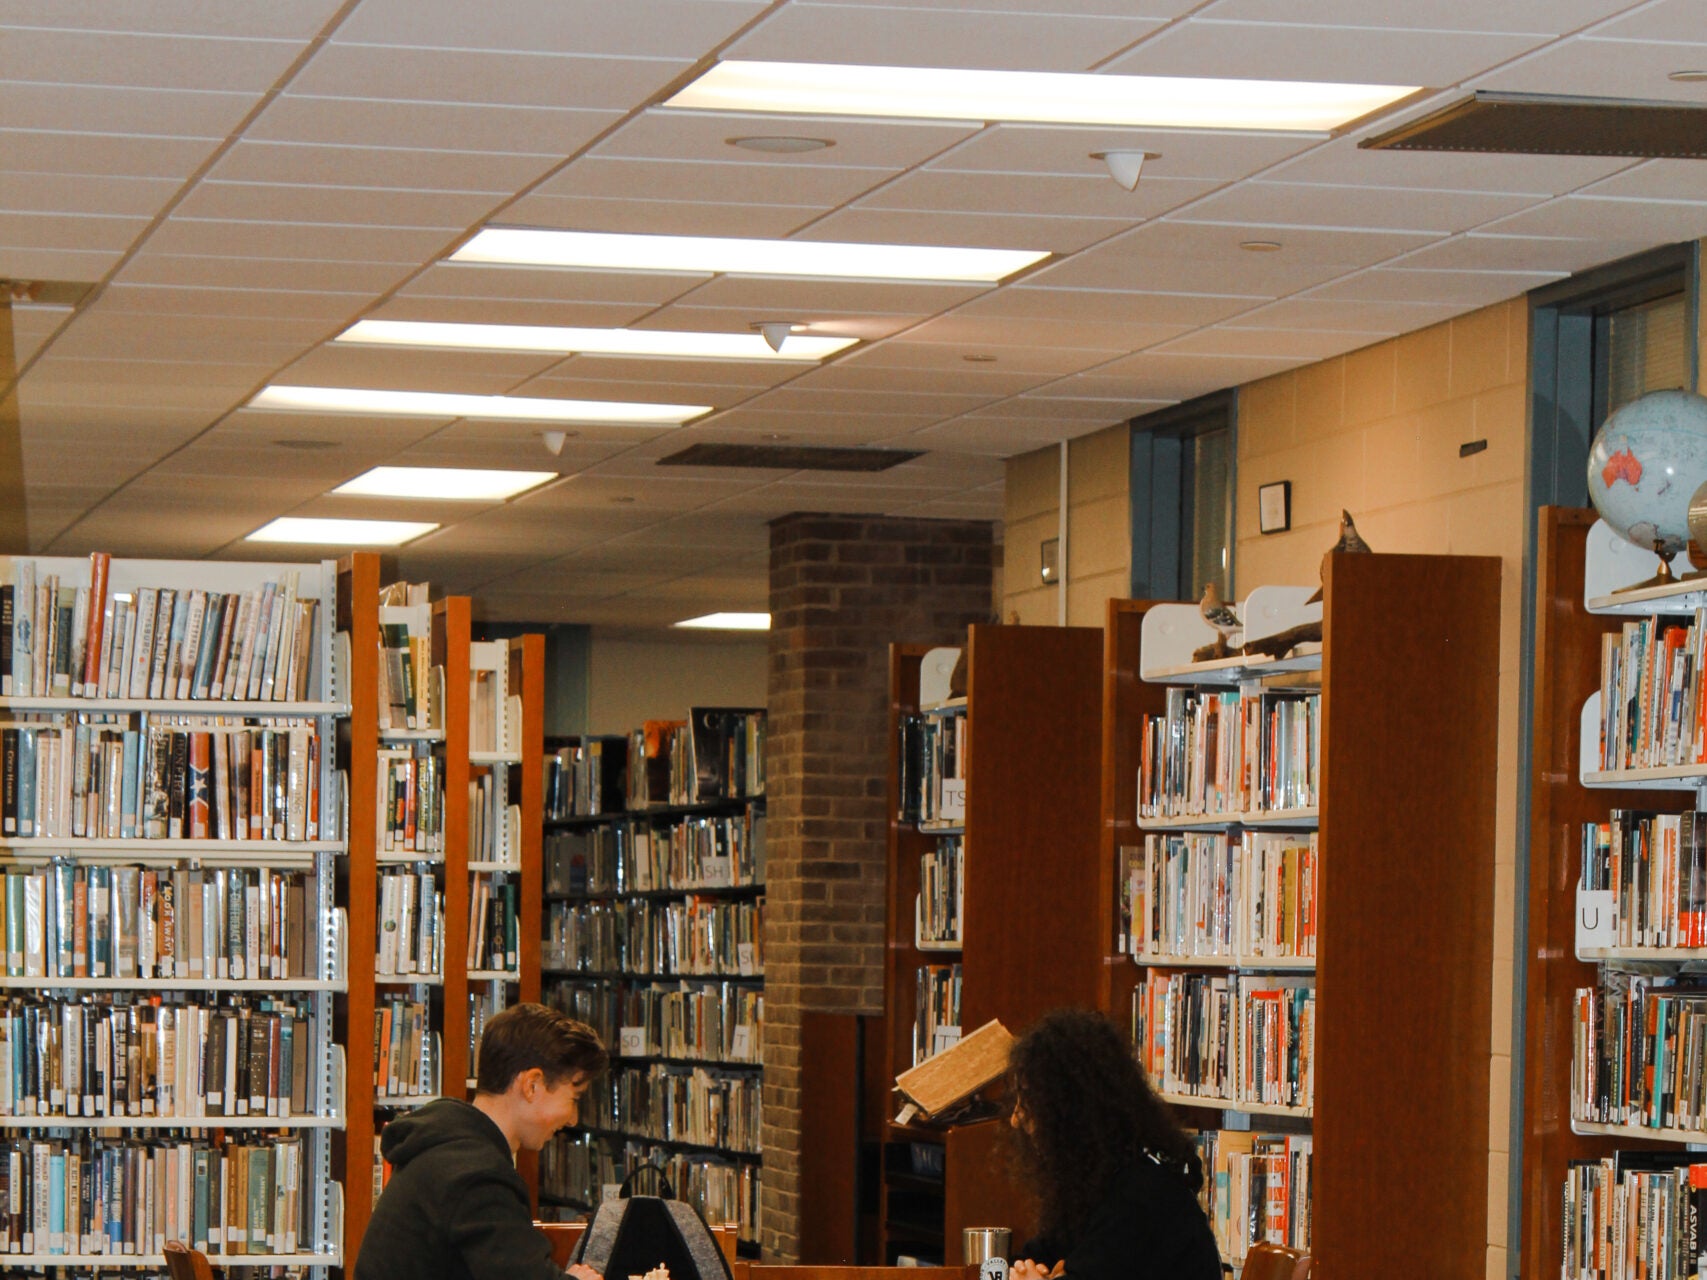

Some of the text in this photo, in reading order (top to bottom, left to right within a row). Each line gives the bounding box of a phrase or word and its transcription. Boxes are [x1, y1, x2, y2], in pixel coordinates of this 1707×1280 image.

[163, 886, 173, 917] LOOK
[1582, 907, 1599, 930] U
[622, 1035, 640, 1047] SD
